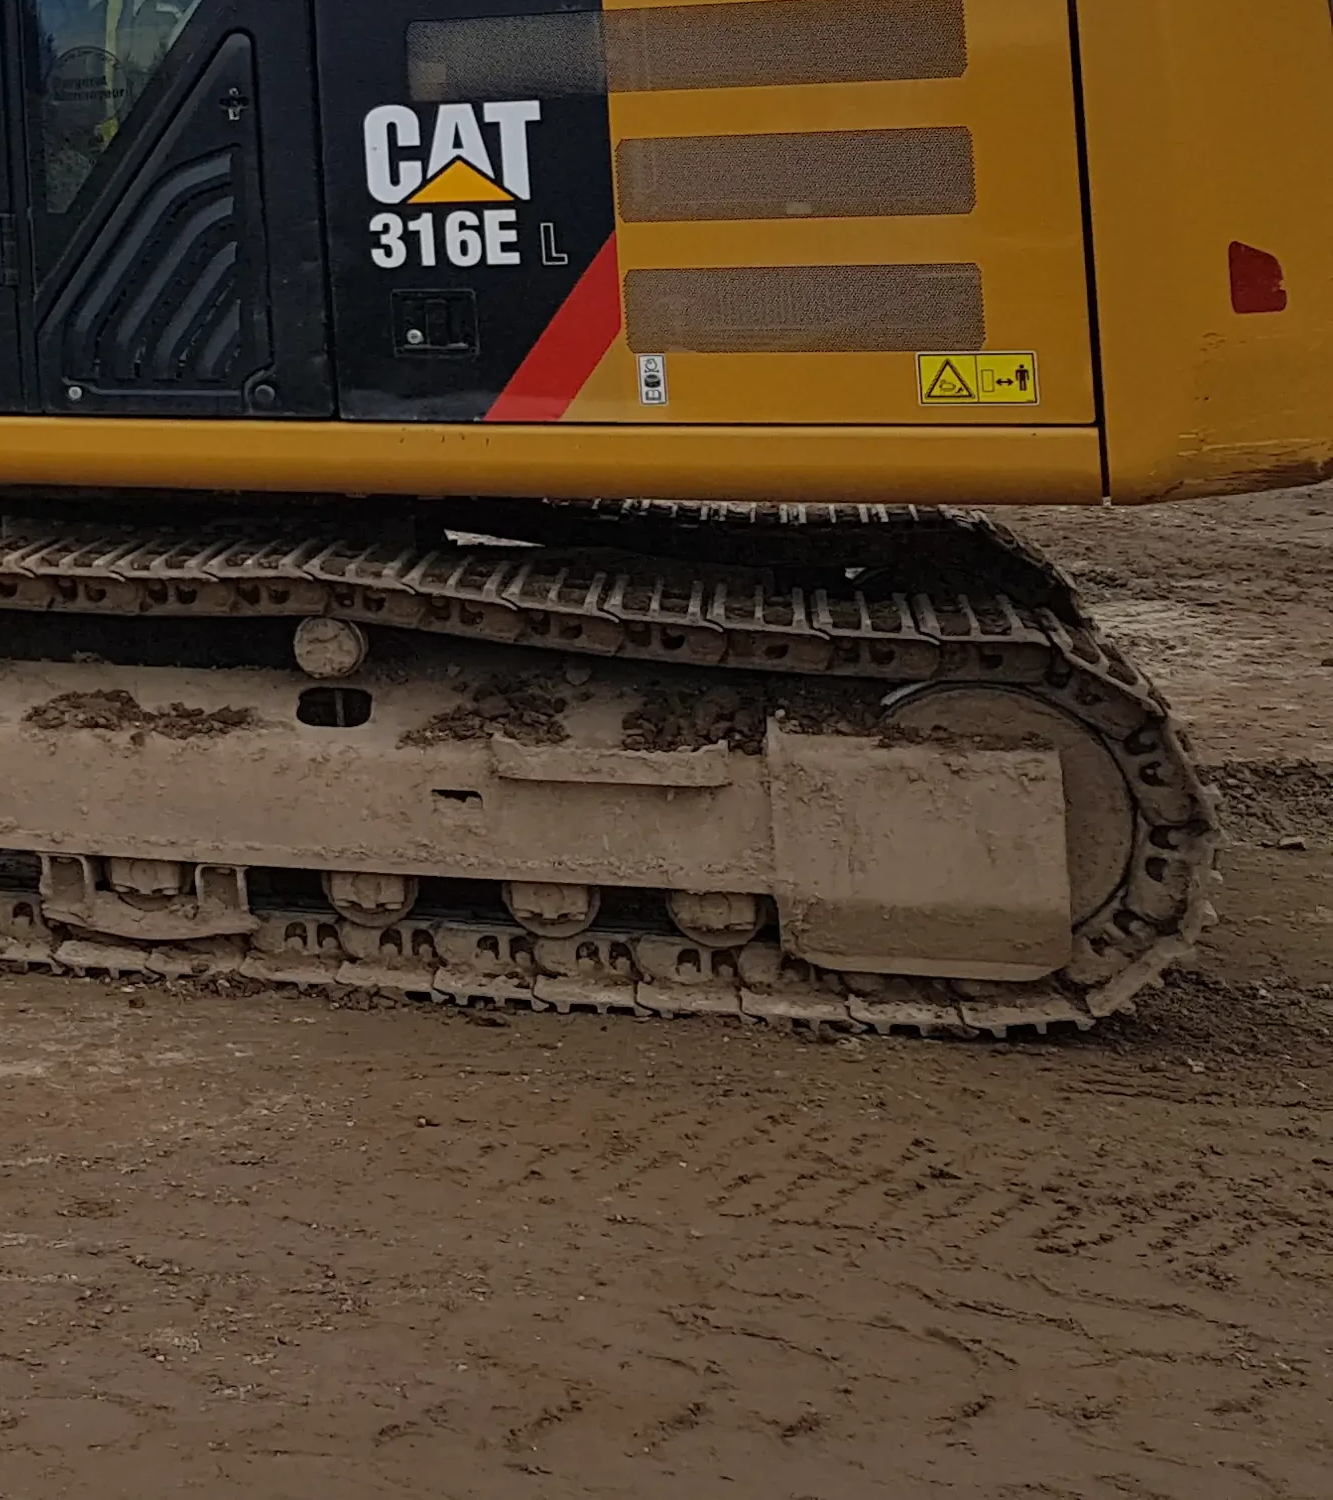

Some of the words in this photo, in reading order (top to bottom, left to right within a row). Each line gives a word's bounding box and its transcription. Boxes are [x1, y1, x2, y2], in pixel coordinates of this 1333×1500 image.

[363, 99, 541, 204] CAT
[369, 208, 521, 269] 316E
[540, 222, 569, 266] L
